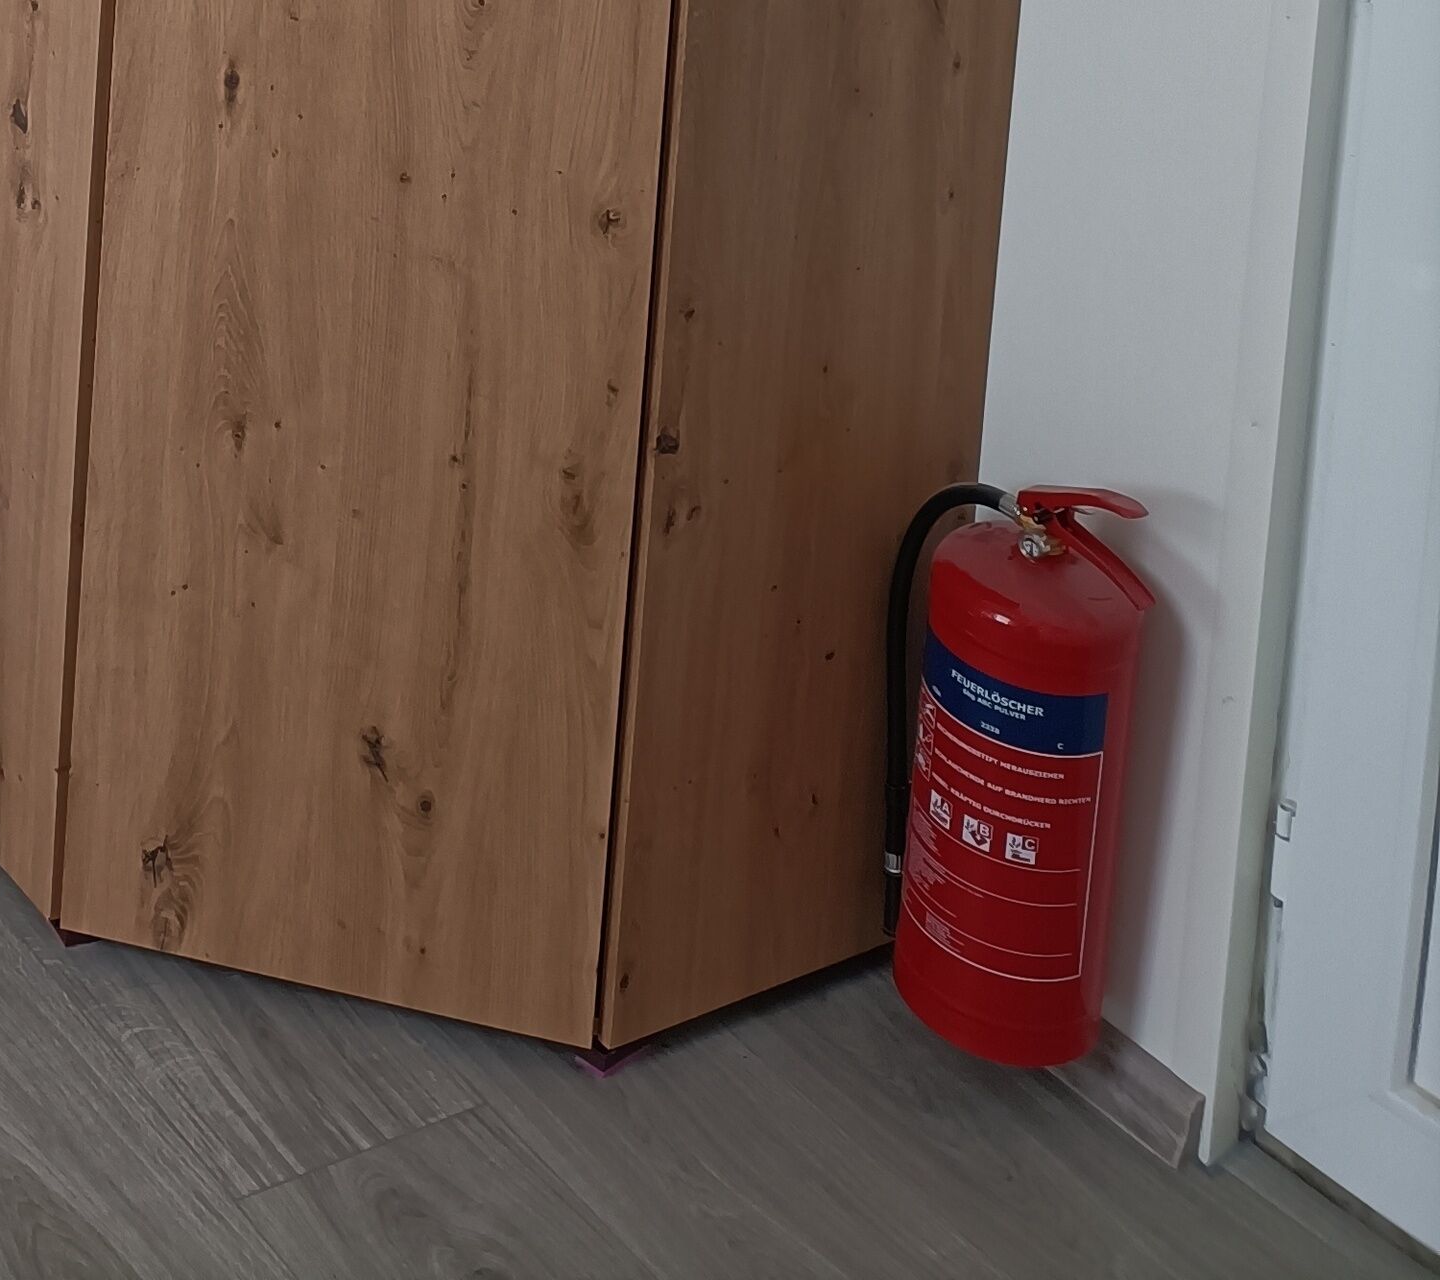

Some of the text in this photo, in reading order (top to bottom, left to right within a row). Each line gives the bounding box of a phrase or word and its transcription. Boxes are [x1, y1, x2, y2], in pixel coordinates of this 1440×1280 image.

[951, 668, 1044, 717] FEUERLÖSCHER
[977, 697, 993, 709] ABC
[994, 705, 1026, 720] PULVER
[1057, 742, 1064, 750] C
[980, 824, 990, 837] B
[1024, 839, 1036, 850] C
